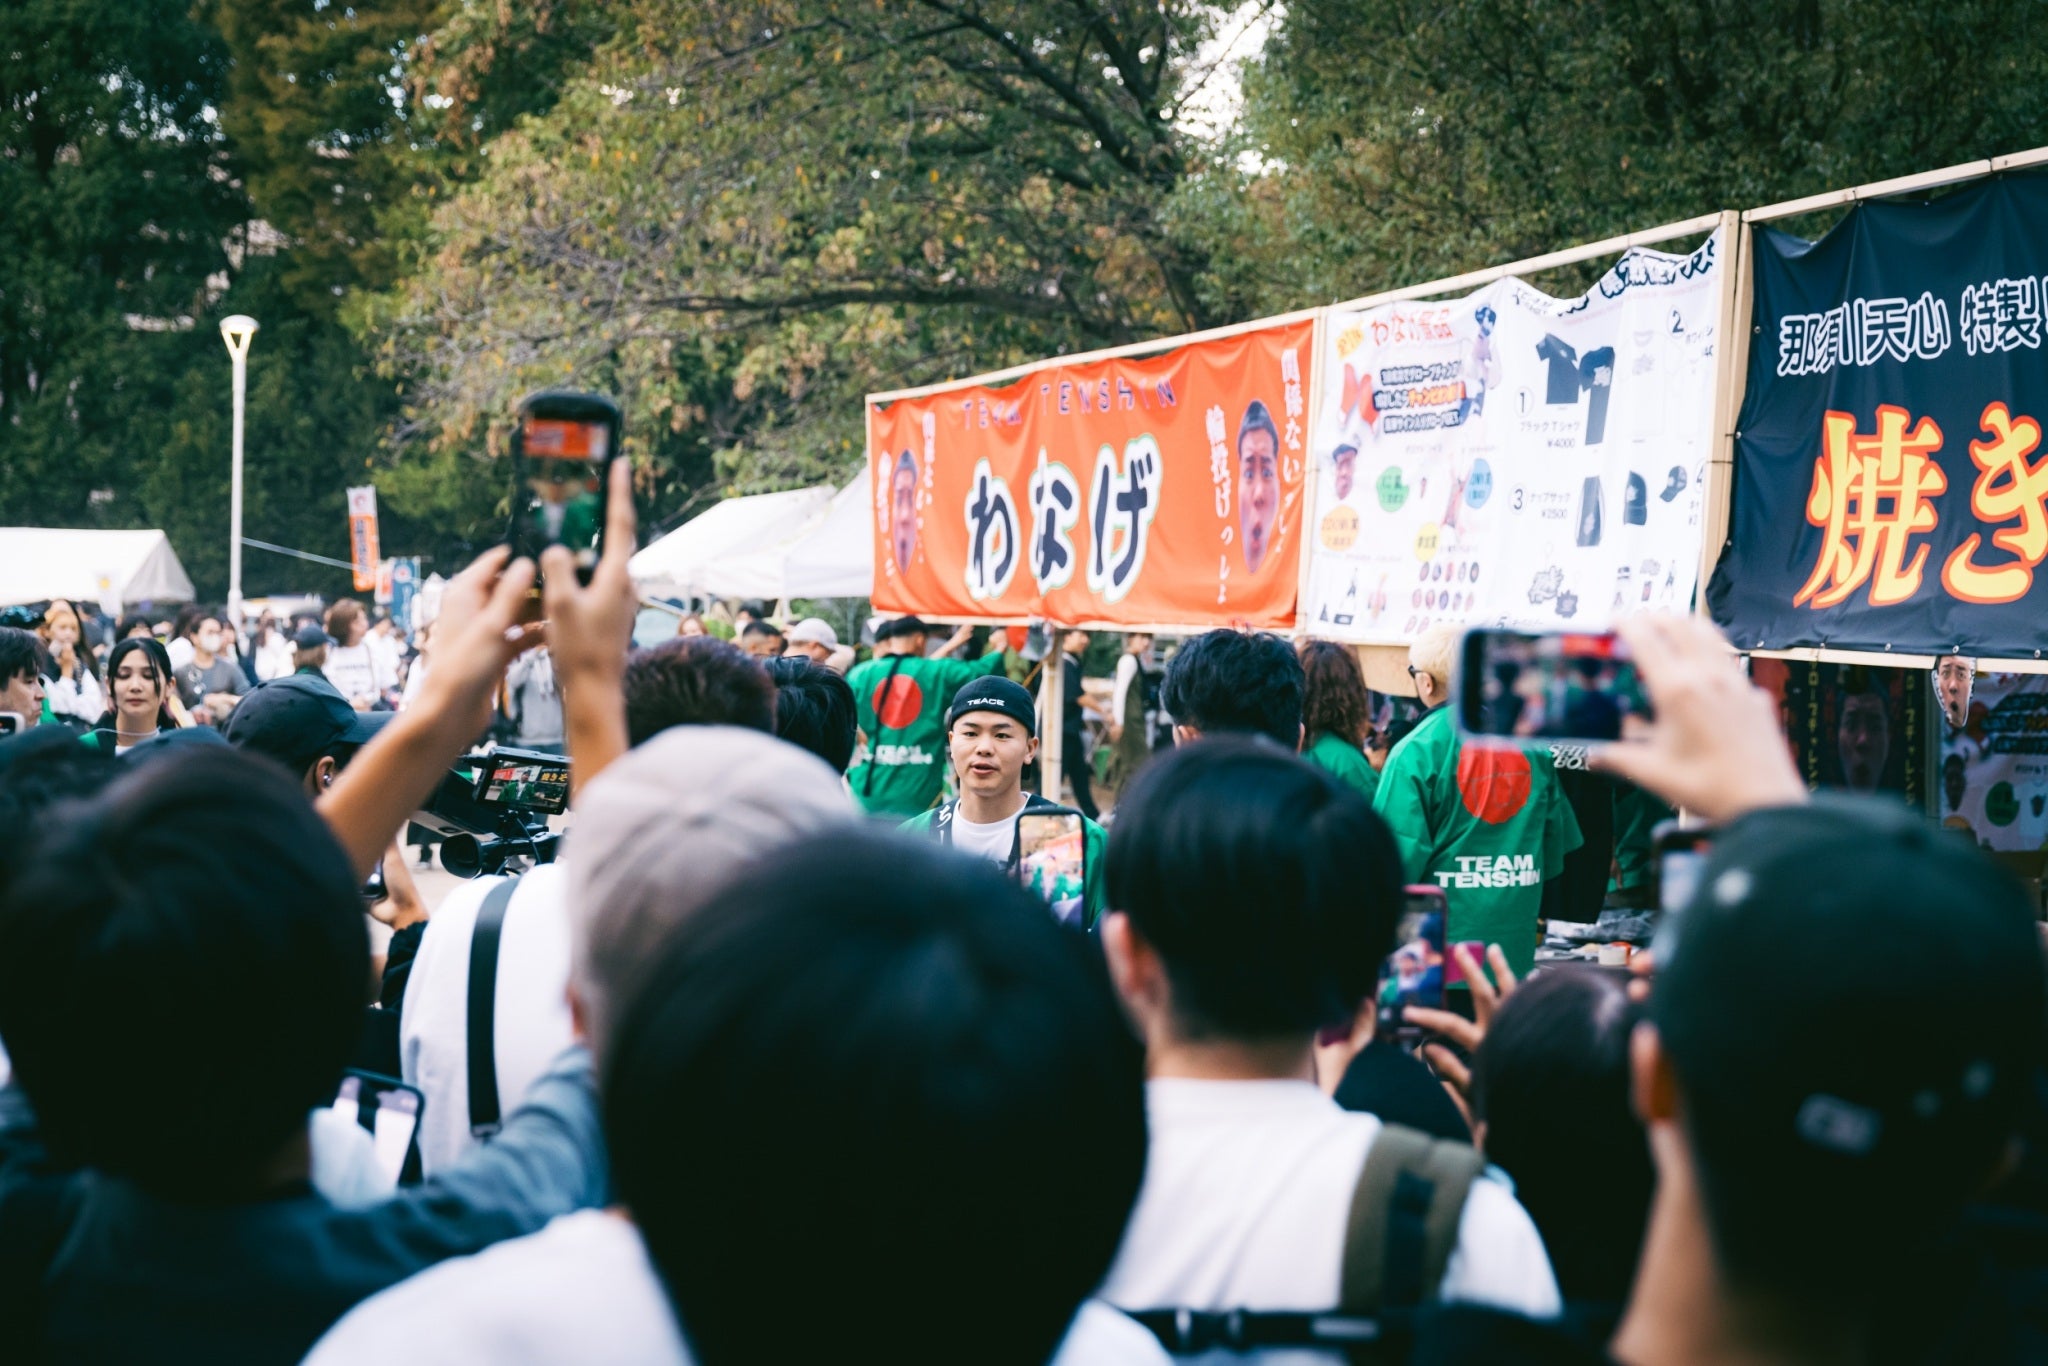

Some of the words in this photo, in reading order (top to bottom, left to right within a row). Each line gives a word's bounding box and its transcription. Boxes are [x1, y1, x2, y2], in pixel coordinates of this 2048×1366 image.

[1777, 292, 1951, 377] 那須川天心
[1961, 273, 2048, 358] 特製
[1513, 488, 1524, 510] 3
[965, 433, 1163, 604] わなげ
[1455, 854, 1534, 873] TEAM
[1433, 869, 1541, 889] TENSHIN
